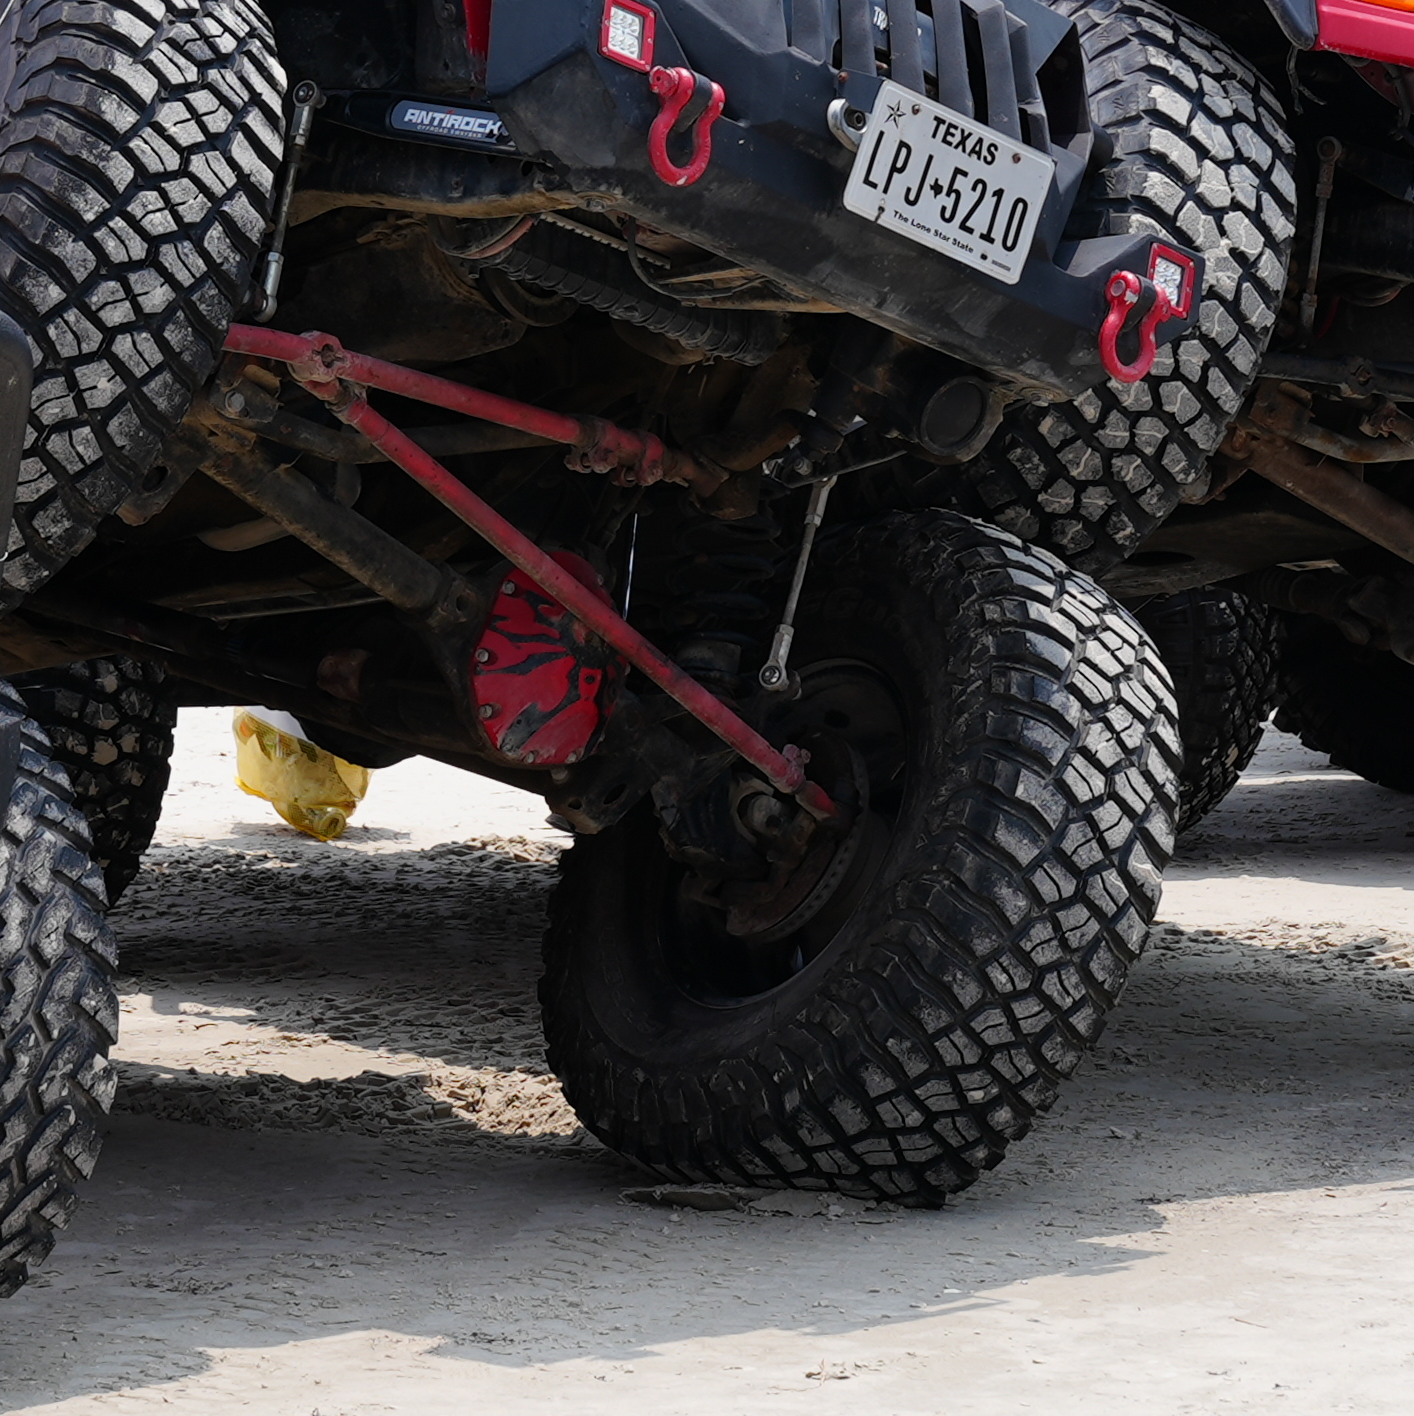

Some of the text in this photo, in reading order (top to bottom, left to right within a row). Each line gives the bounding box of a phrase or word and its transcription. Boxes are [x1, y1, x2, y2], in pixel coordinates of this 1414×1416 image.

[403, 107, 504, 135] ANTIROCK
[931, 115, 999, 166] TEXAS
[893, 210, 974, 254] The Lone Star State
